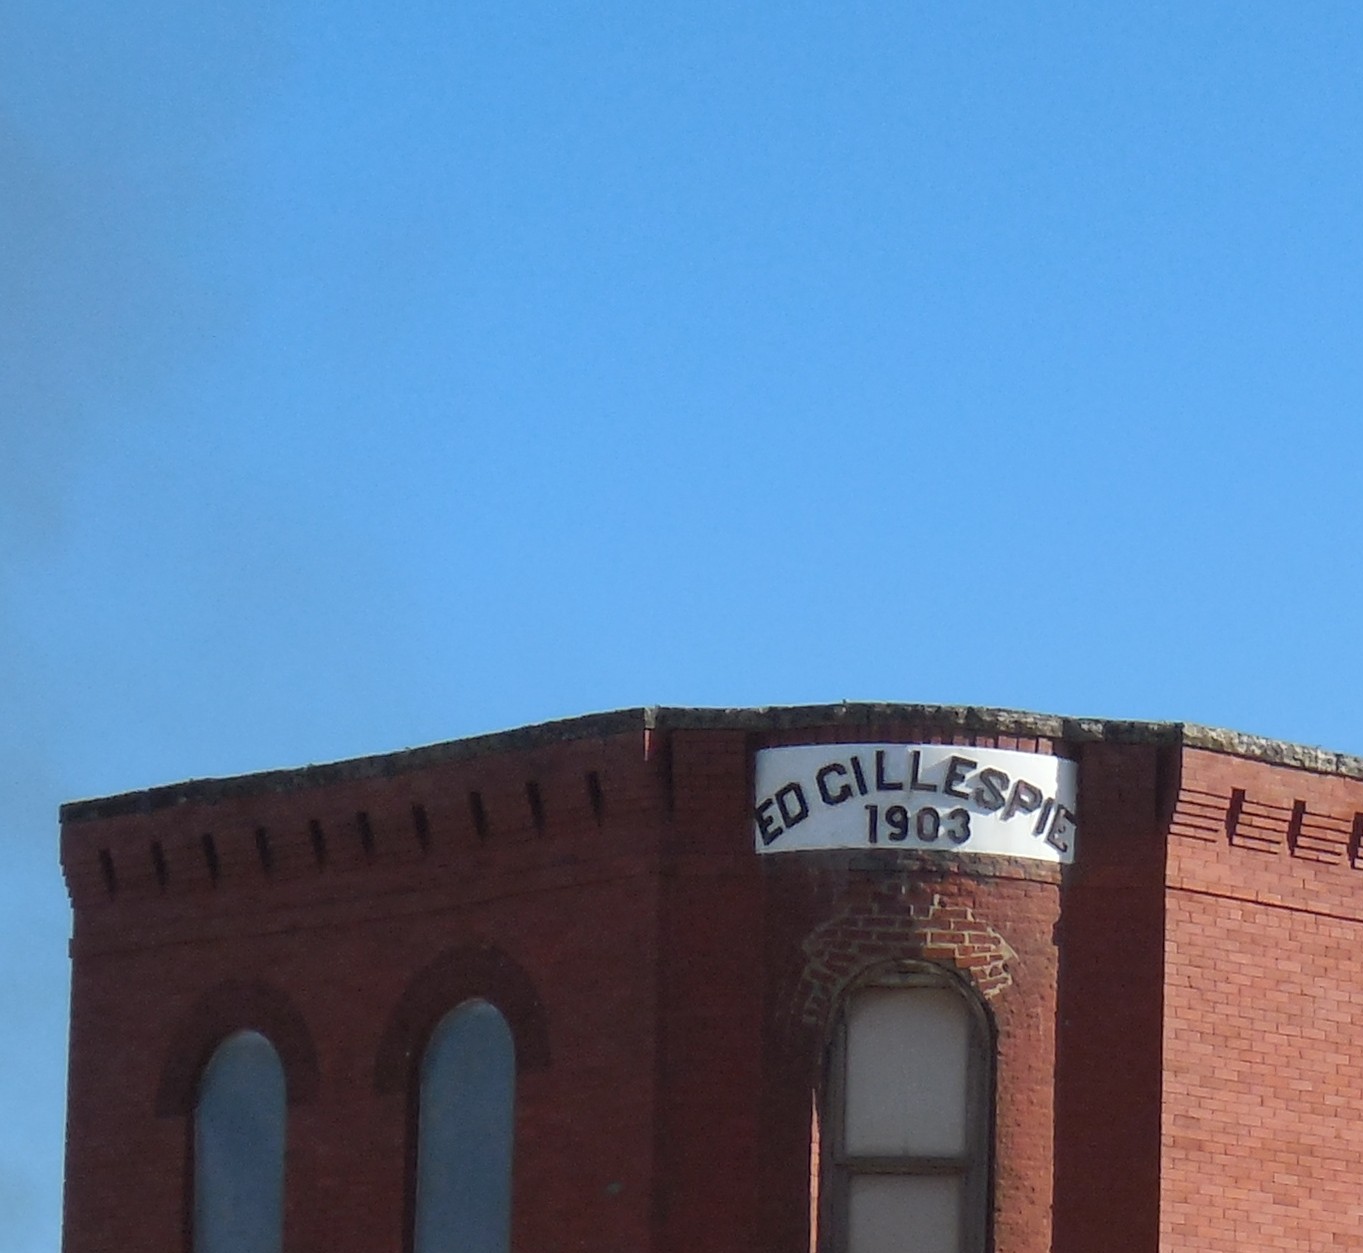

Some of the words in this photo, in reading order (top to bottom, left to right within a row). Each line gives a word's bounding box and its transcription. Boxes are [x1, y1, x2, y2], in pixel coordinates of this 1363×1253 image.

[753, 781, 810, 846] ED
[814, 749, 1077, 853] GILLESPIE
[863, 803, 972, 844] 1903
